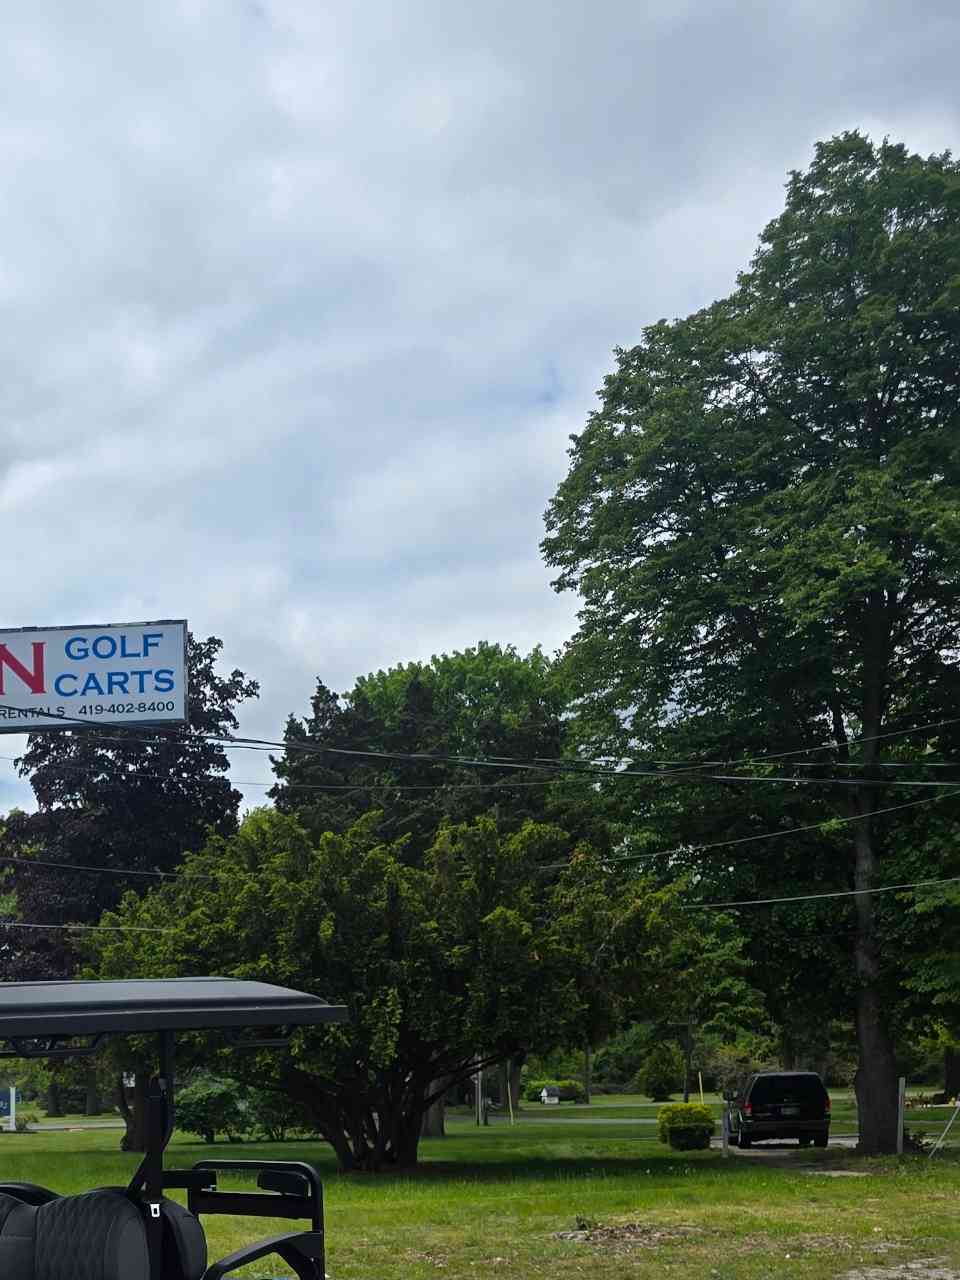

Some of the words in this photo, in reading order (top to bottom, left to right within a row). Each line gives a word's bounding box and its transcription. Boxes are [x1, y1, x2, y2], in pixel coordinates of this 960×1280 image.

[65, 633, 163, 660] GOLF
[54, 669, 175, 697] CARTS
[78, 701, 175, 715] 419-402-8400
